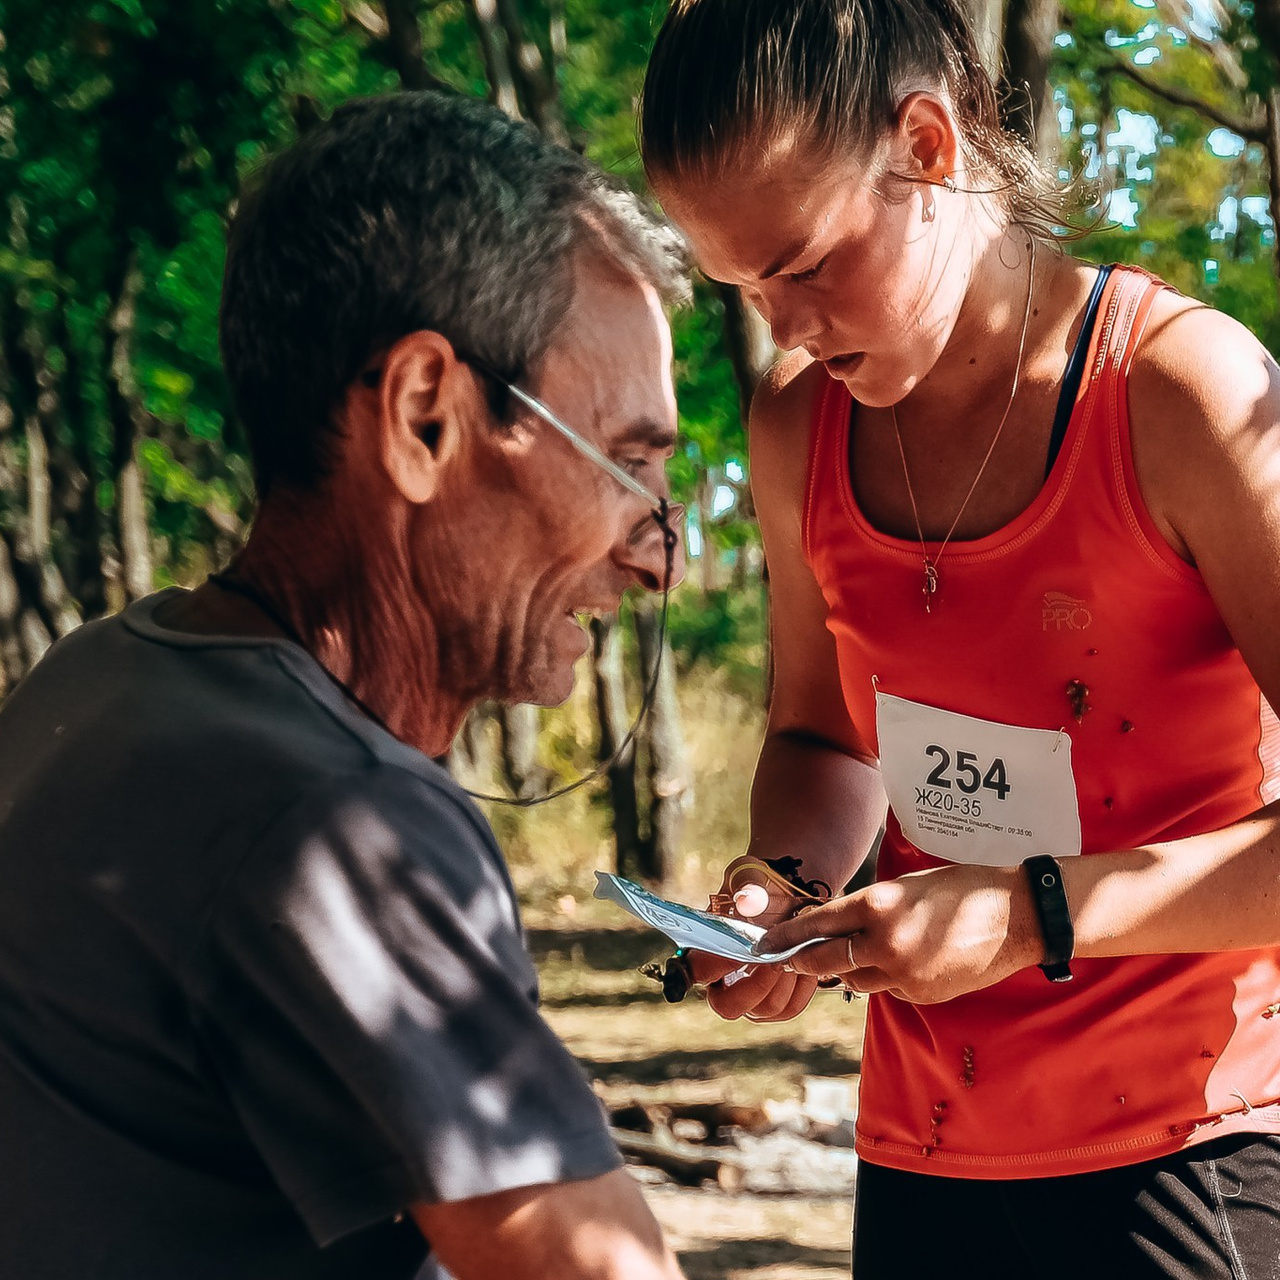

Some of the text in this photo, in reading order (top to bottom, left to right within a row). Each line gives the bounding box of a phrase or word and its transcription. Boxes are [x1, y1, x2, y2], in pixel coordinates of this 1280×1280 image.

[1042, 608, 1092, 631] PRO
[925, 744, 1011, 801] 254
[915, 787, 981, 817] Ж20-35
